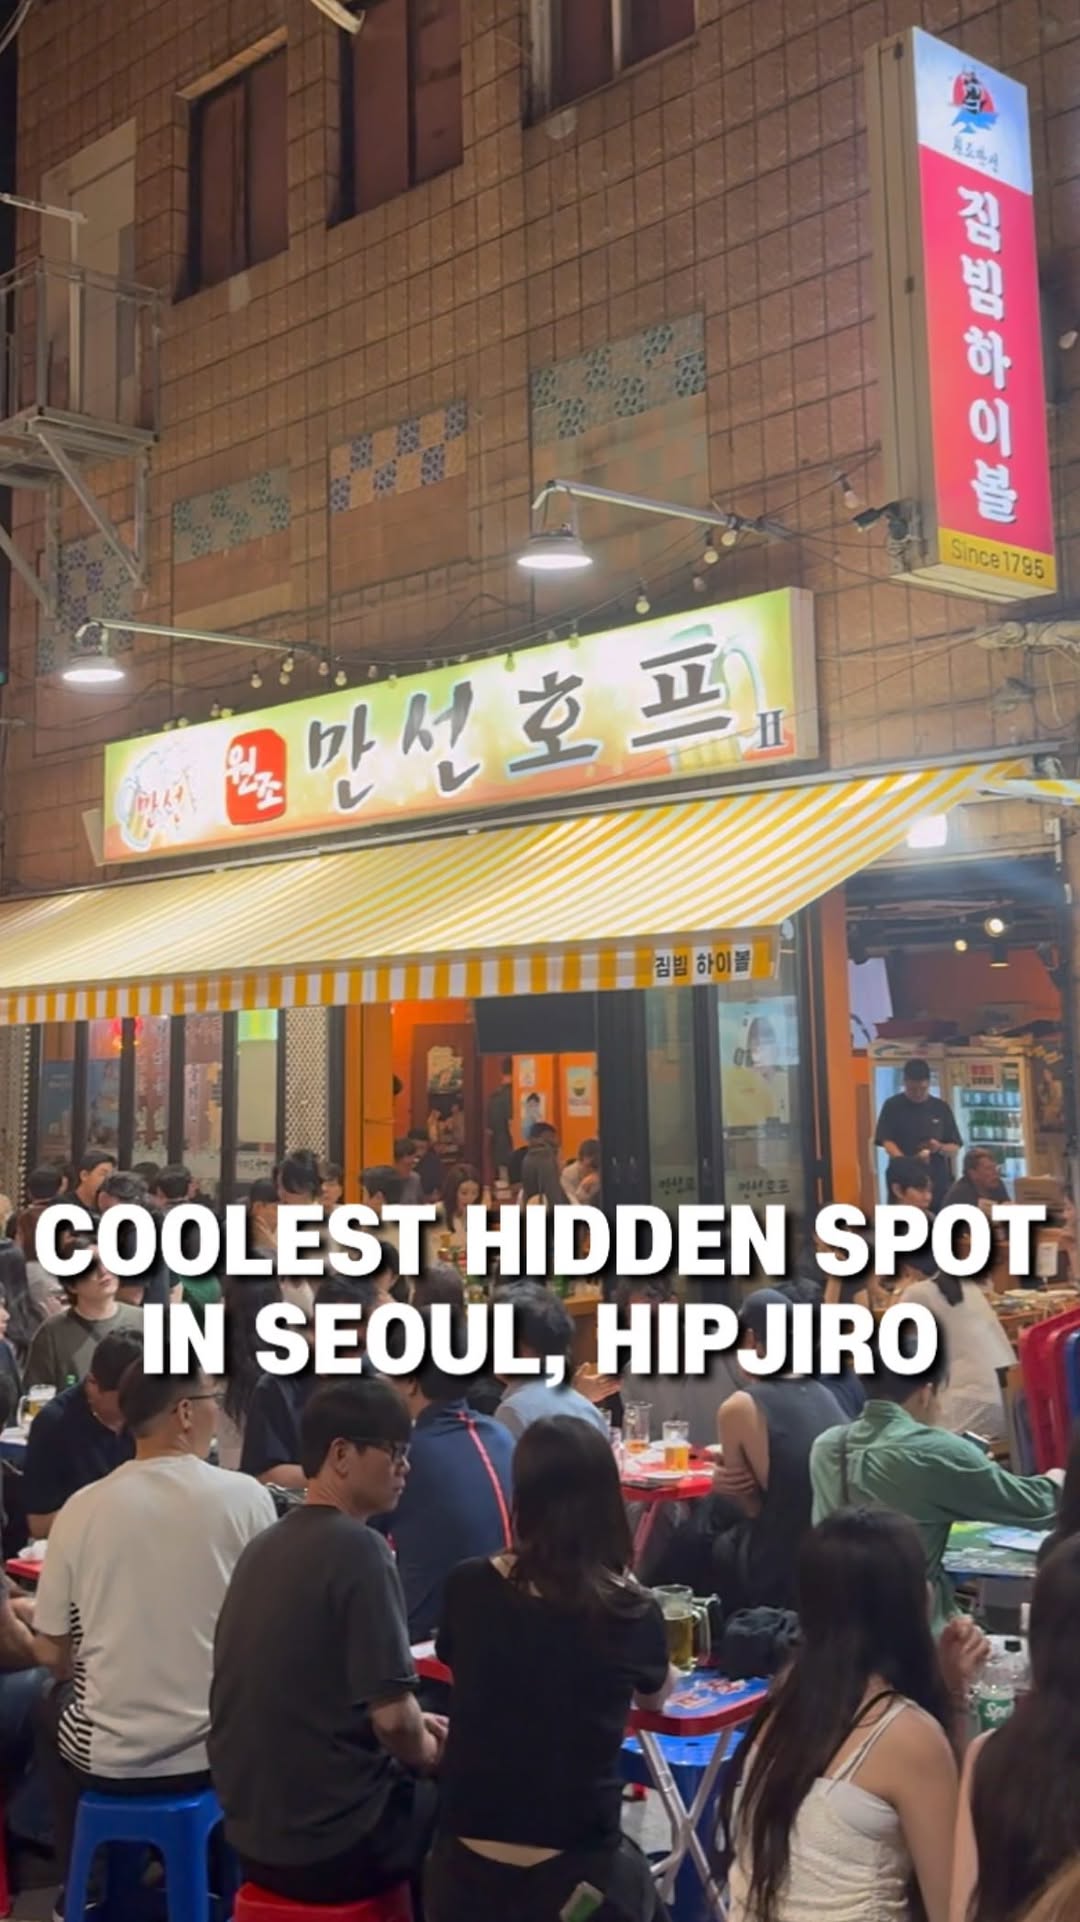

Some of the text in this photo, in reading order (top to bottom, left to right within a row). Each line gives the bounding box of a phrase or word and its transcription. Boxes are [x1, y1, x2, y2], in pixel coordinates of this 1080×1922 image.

[951, 537, 1045, 579] Since 1795
[225, 744, 283, 812] 원조
[696, 949, 750, 975] 하이볼
